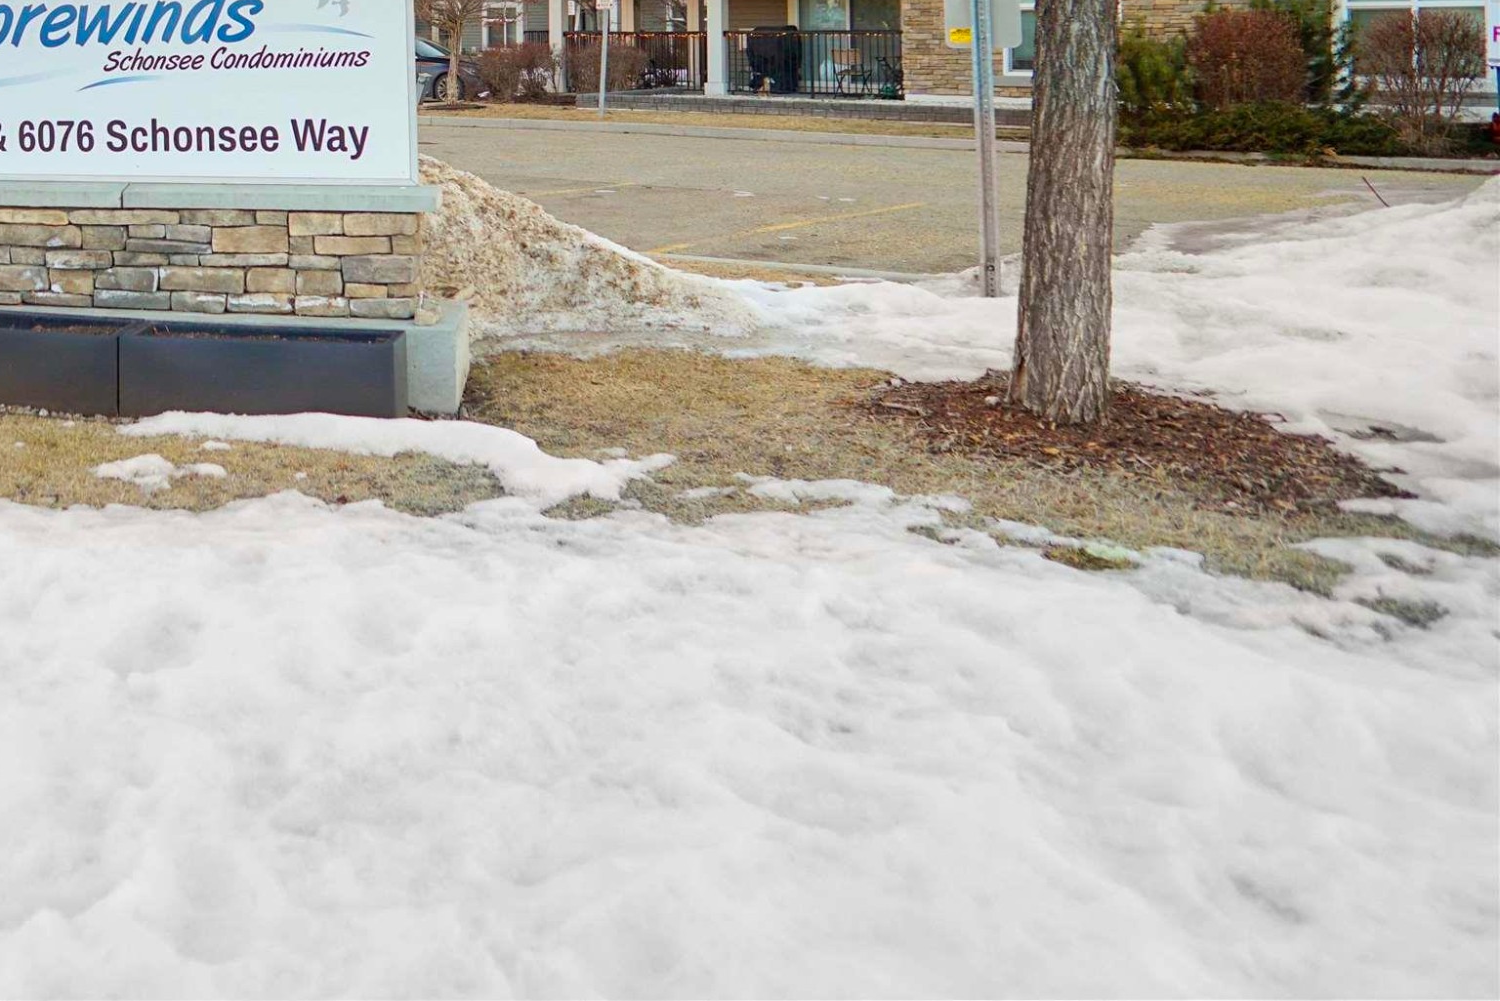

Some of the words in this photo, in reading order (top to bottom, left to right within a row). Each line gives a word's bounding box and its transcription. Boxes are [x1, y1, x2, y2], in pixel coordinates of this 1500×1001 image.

[103, 48, 204, 72] Schonsee
[210, 45, 371, 69] Condominiums
[18, 119, 95, 152] 6076
[106, 118, 279, 152] Schonsee
[290, 118, 369, 160] Way
